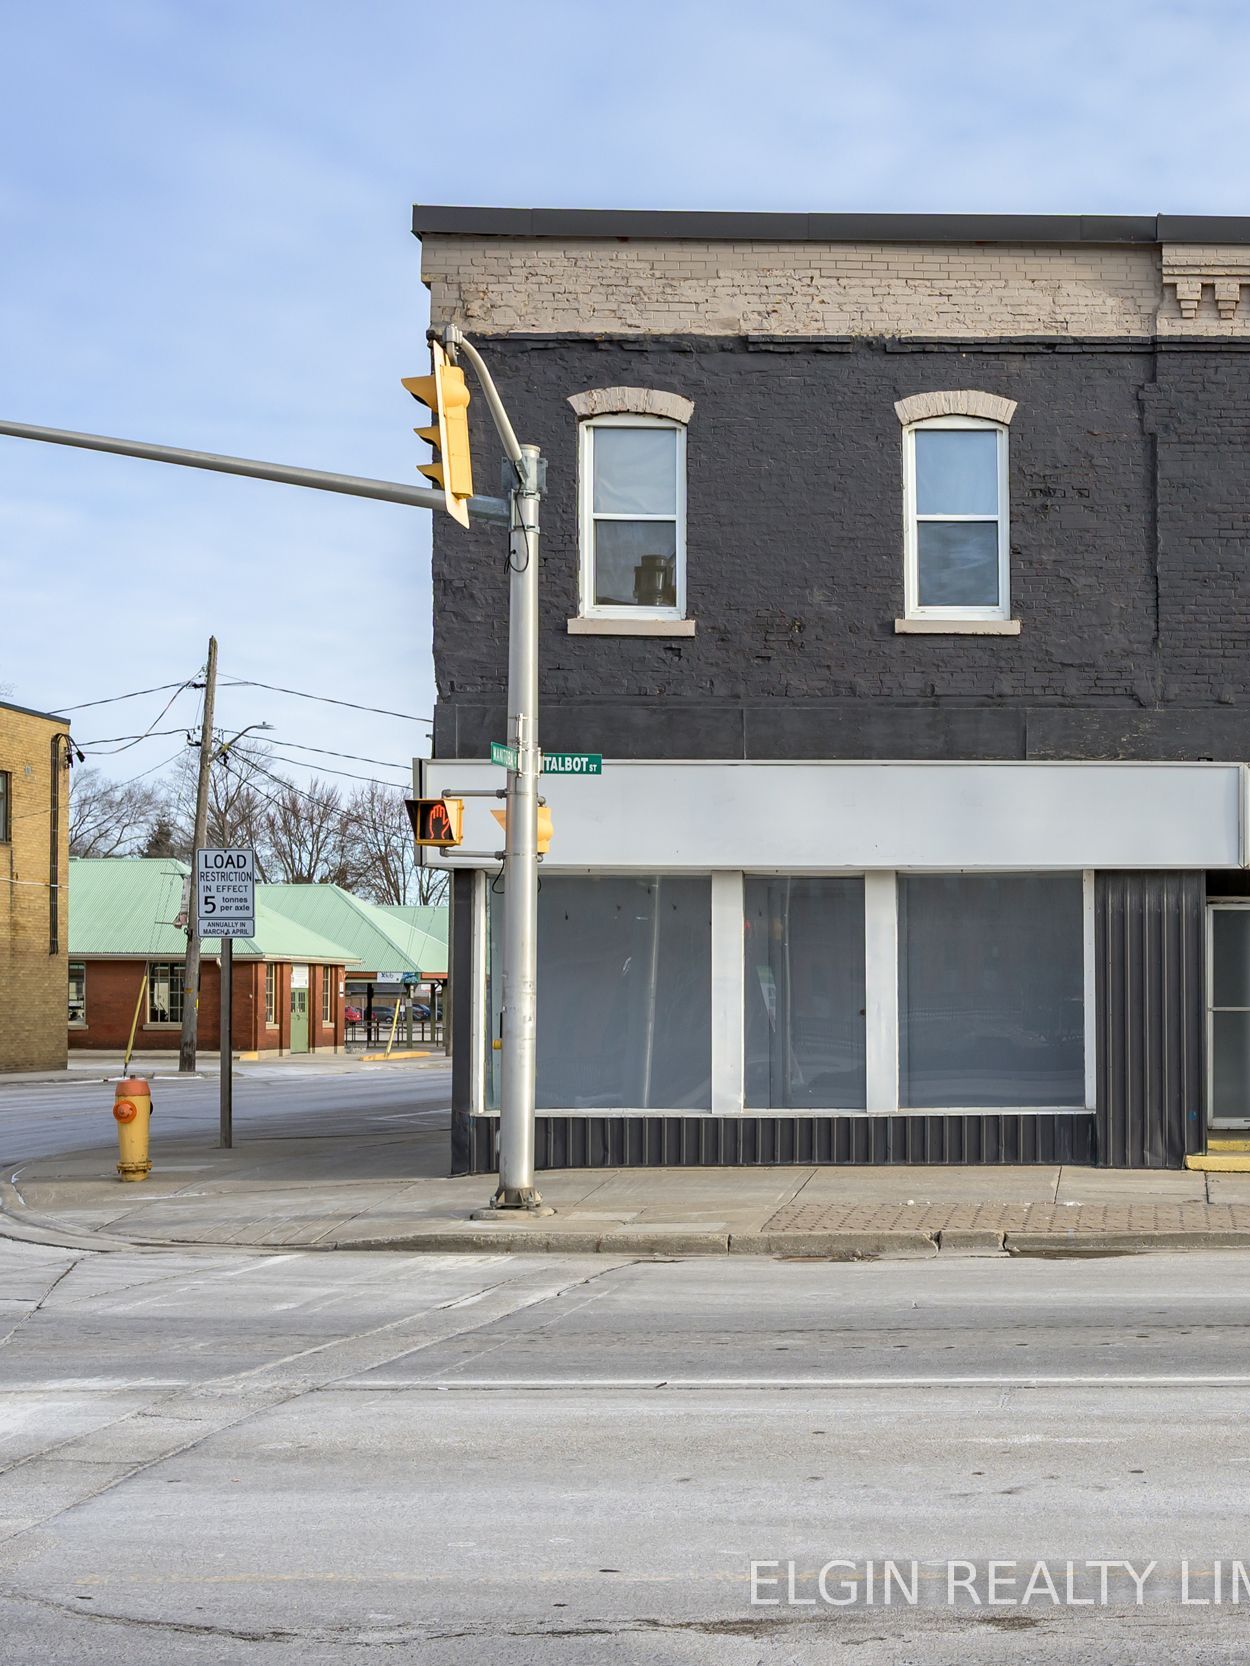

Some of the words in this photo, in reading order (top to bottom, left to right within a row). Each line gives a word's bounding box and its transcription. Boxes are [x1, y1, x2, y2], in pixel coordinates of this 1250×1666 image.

[544, 757, 589, 772] TALBOT
[589, 764, 597, 772] ST
[204, 854, 247, 869] LOAD
[200, 871, 252, 882] RESTRICTION
[203, 885, 212, 893] IN
[216, 885, 248, 893] EFFECT
[204, 896, 216, 914] 5
[222, 896, 248, 904] tonnes
